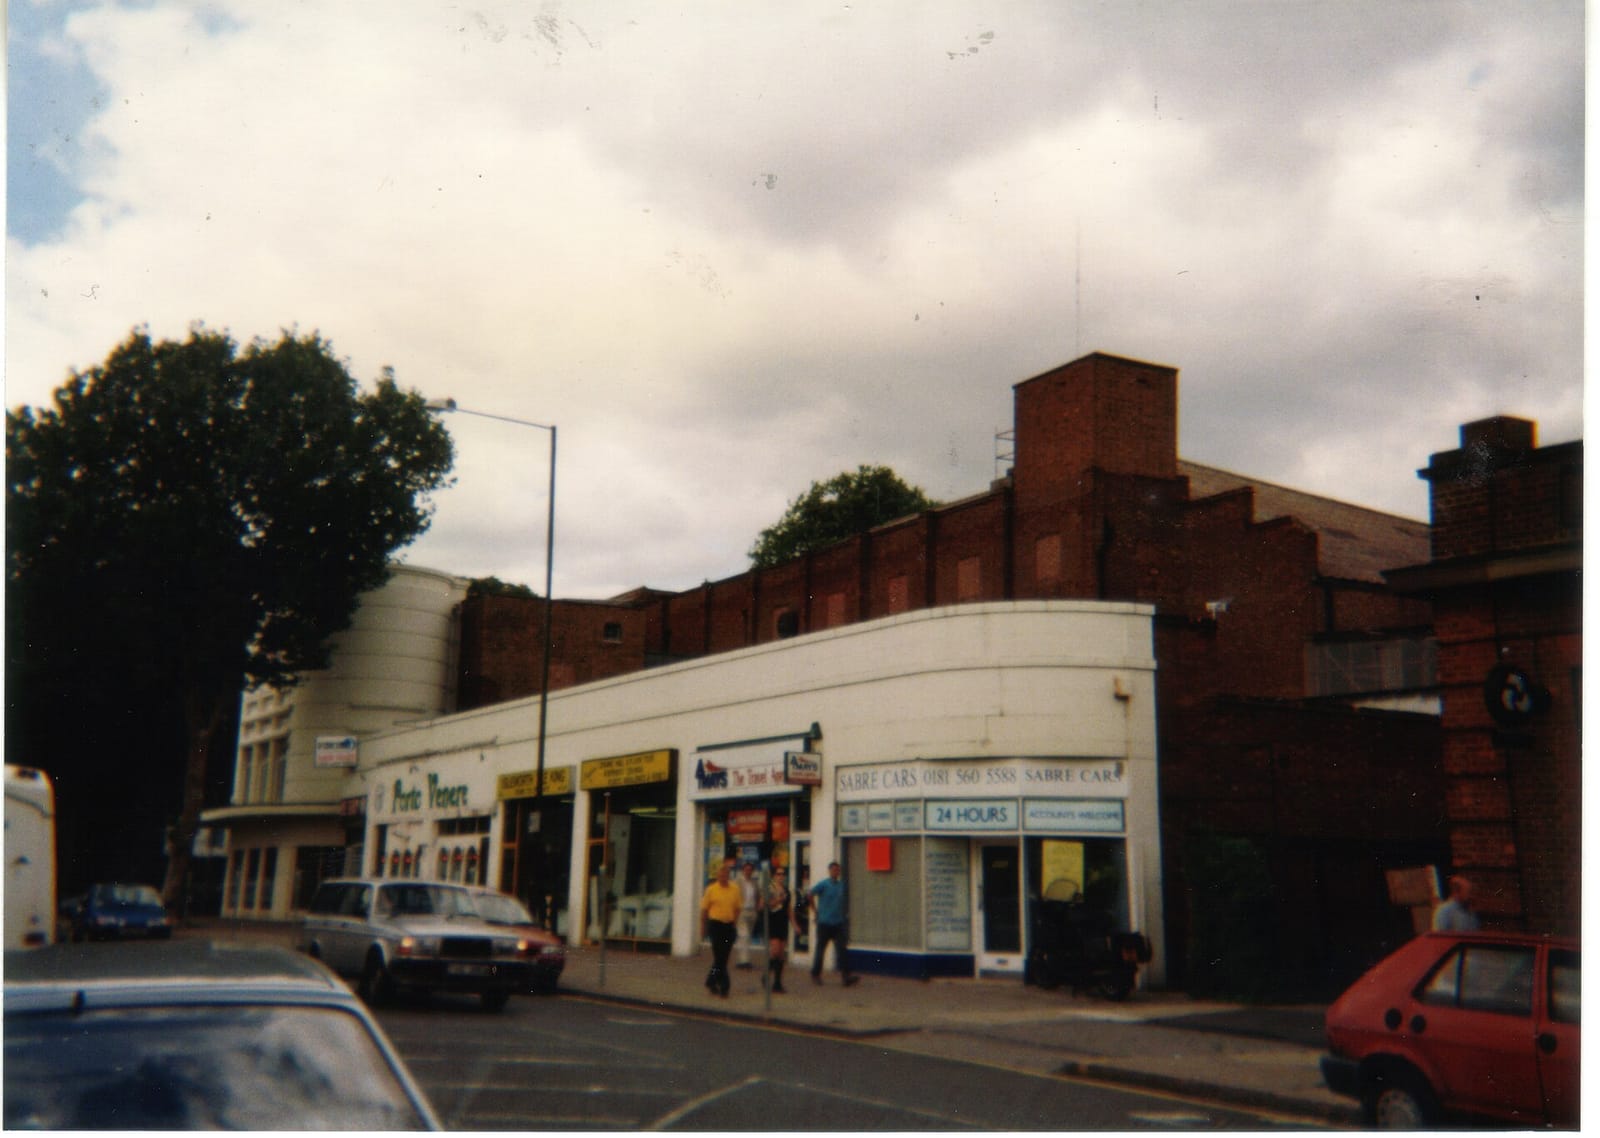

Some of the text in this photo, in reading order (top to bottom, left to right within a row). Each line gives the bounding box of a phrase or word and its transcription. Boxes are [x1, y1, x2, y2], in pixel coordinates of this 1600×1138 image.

[733, 769, 745, 786] The
[747, 767, 768, 786] Travel
[840, 767, 918, 792] SABRE CARS
[923, 767, 1017, 785] 0181 560 5588
[1024, 768, 1073, 783] SABRE
[937, 807, 951, 823] 24
[956, 807, 1008, 823] HOURS
